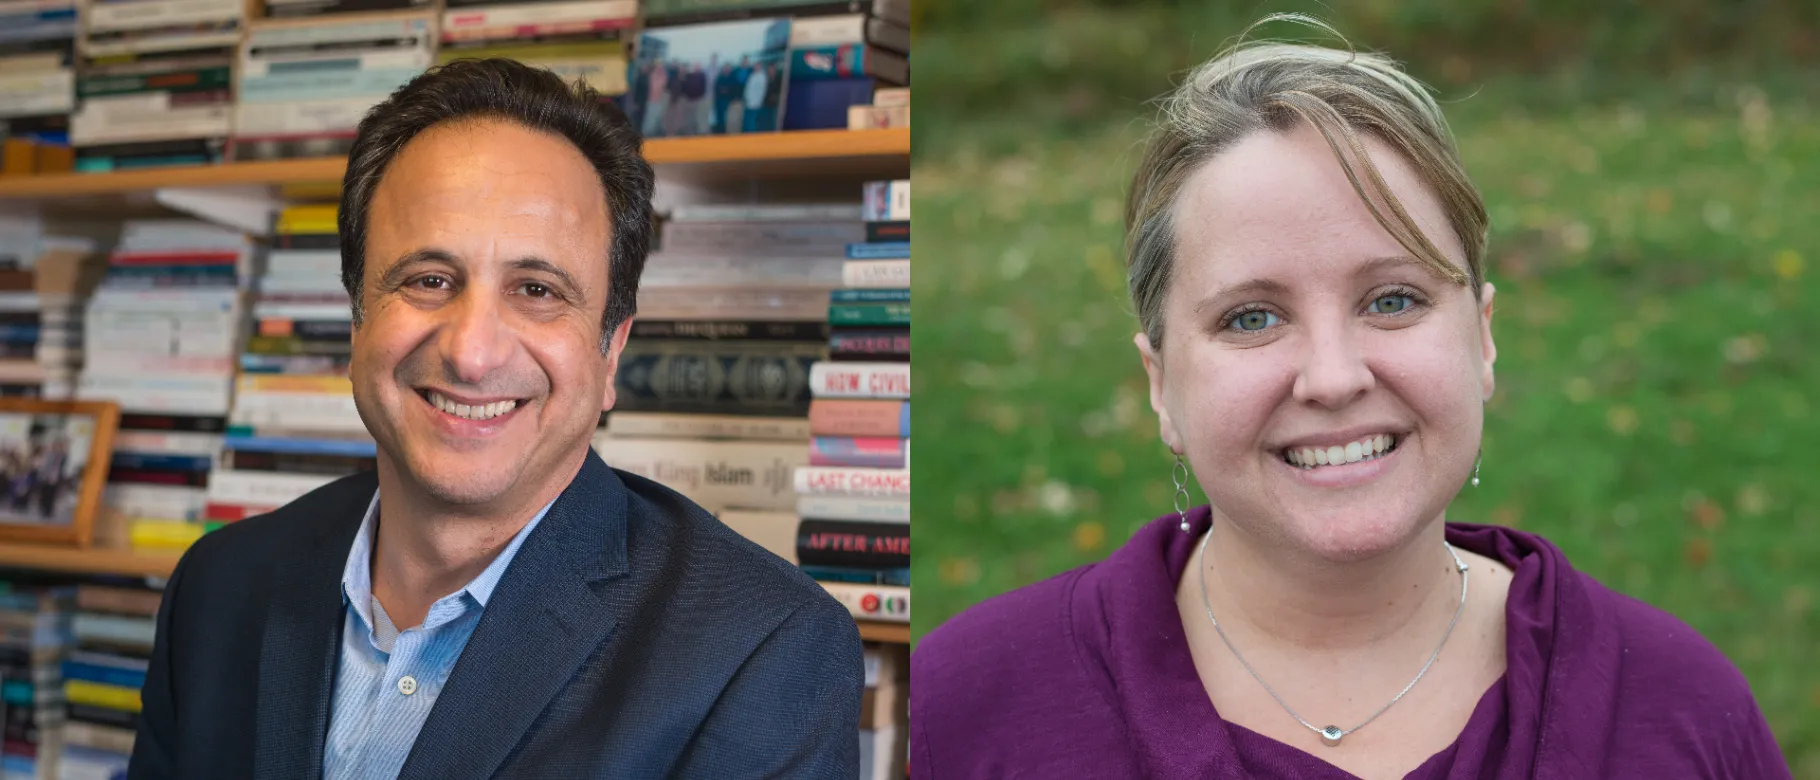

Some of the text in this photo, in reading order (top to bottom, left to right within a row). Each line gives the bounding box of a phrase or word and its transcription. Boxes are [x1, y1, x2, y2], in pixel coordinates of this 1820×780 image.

[825, 372, 860, 390] HOW
[704, 460, 754, 484] Islam
[808, 472, 910, 492] LAST CHANC
[808, 532, 867, 552] AFTER
